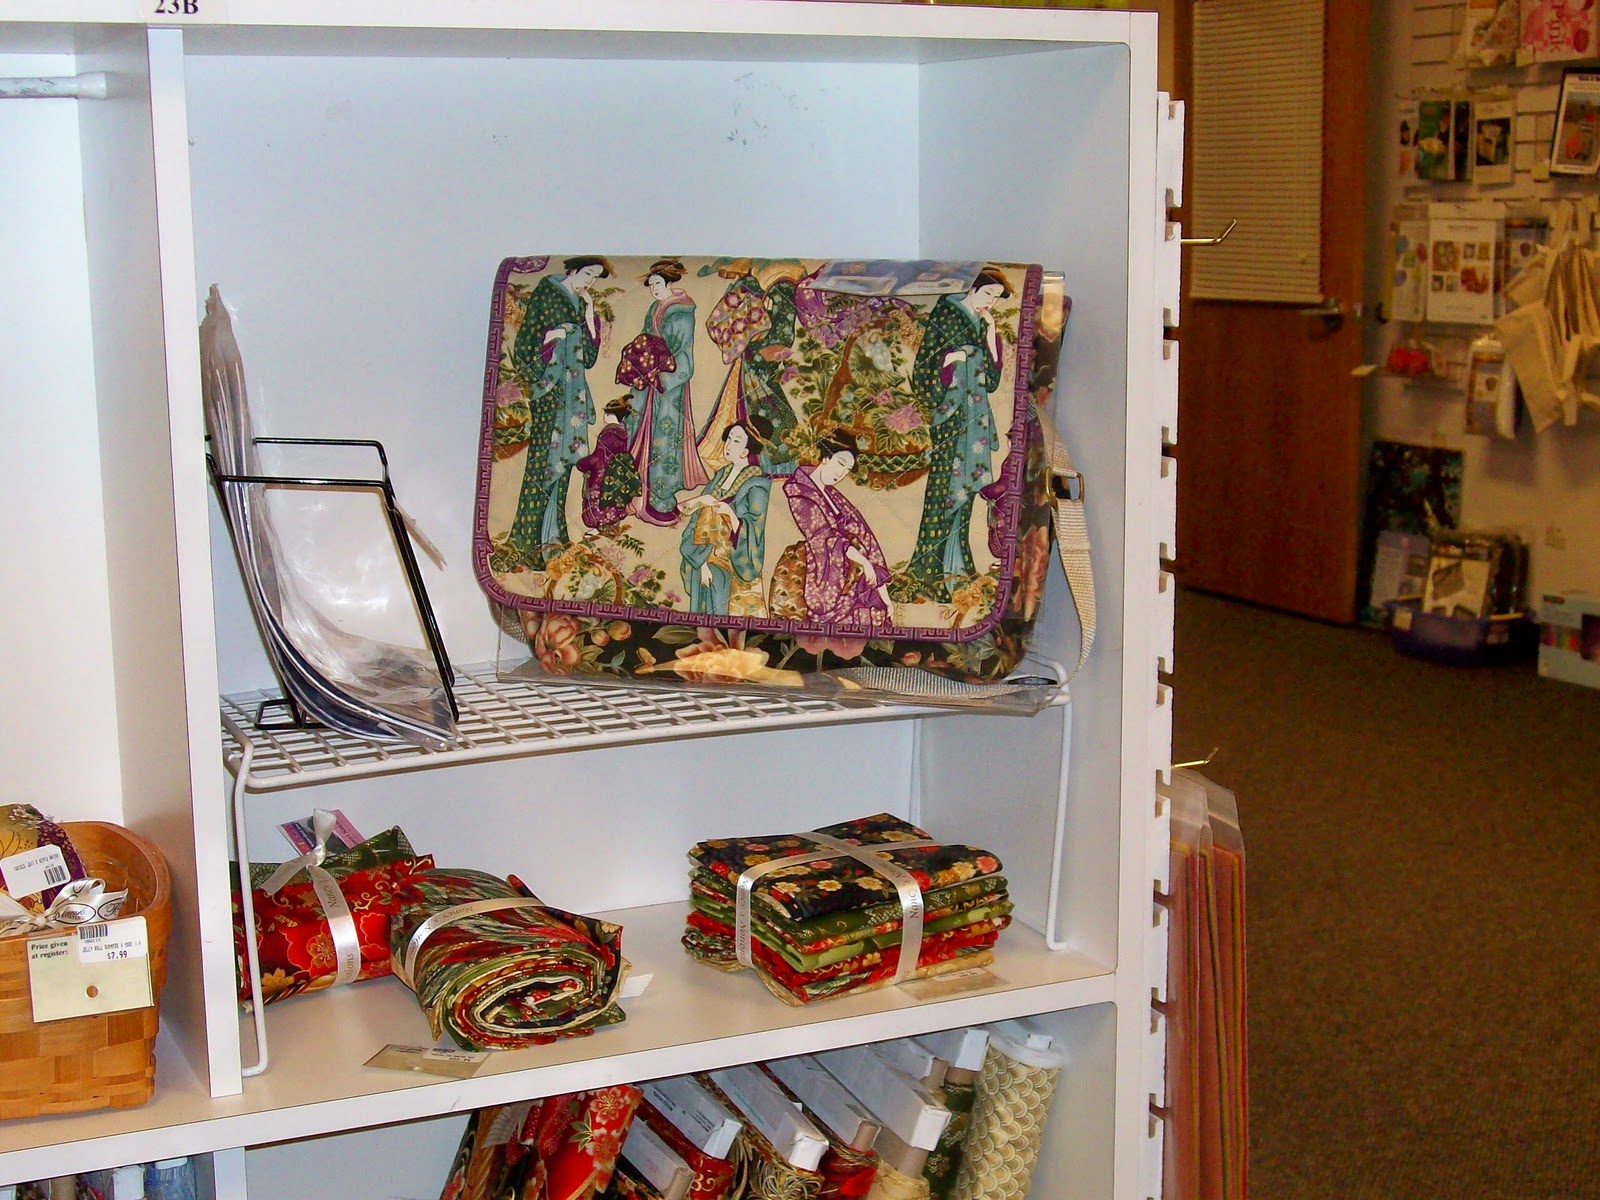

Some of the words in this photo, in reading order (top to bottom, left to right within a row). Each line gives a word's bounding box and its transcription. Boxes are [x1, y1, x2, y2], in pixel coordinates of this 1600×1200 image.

[154, 0, 199, 14] 23B
[30, 943, 49, 951] Price
[49, 941, 68, 949] given
[107, 950, 128, 960] $7.99
